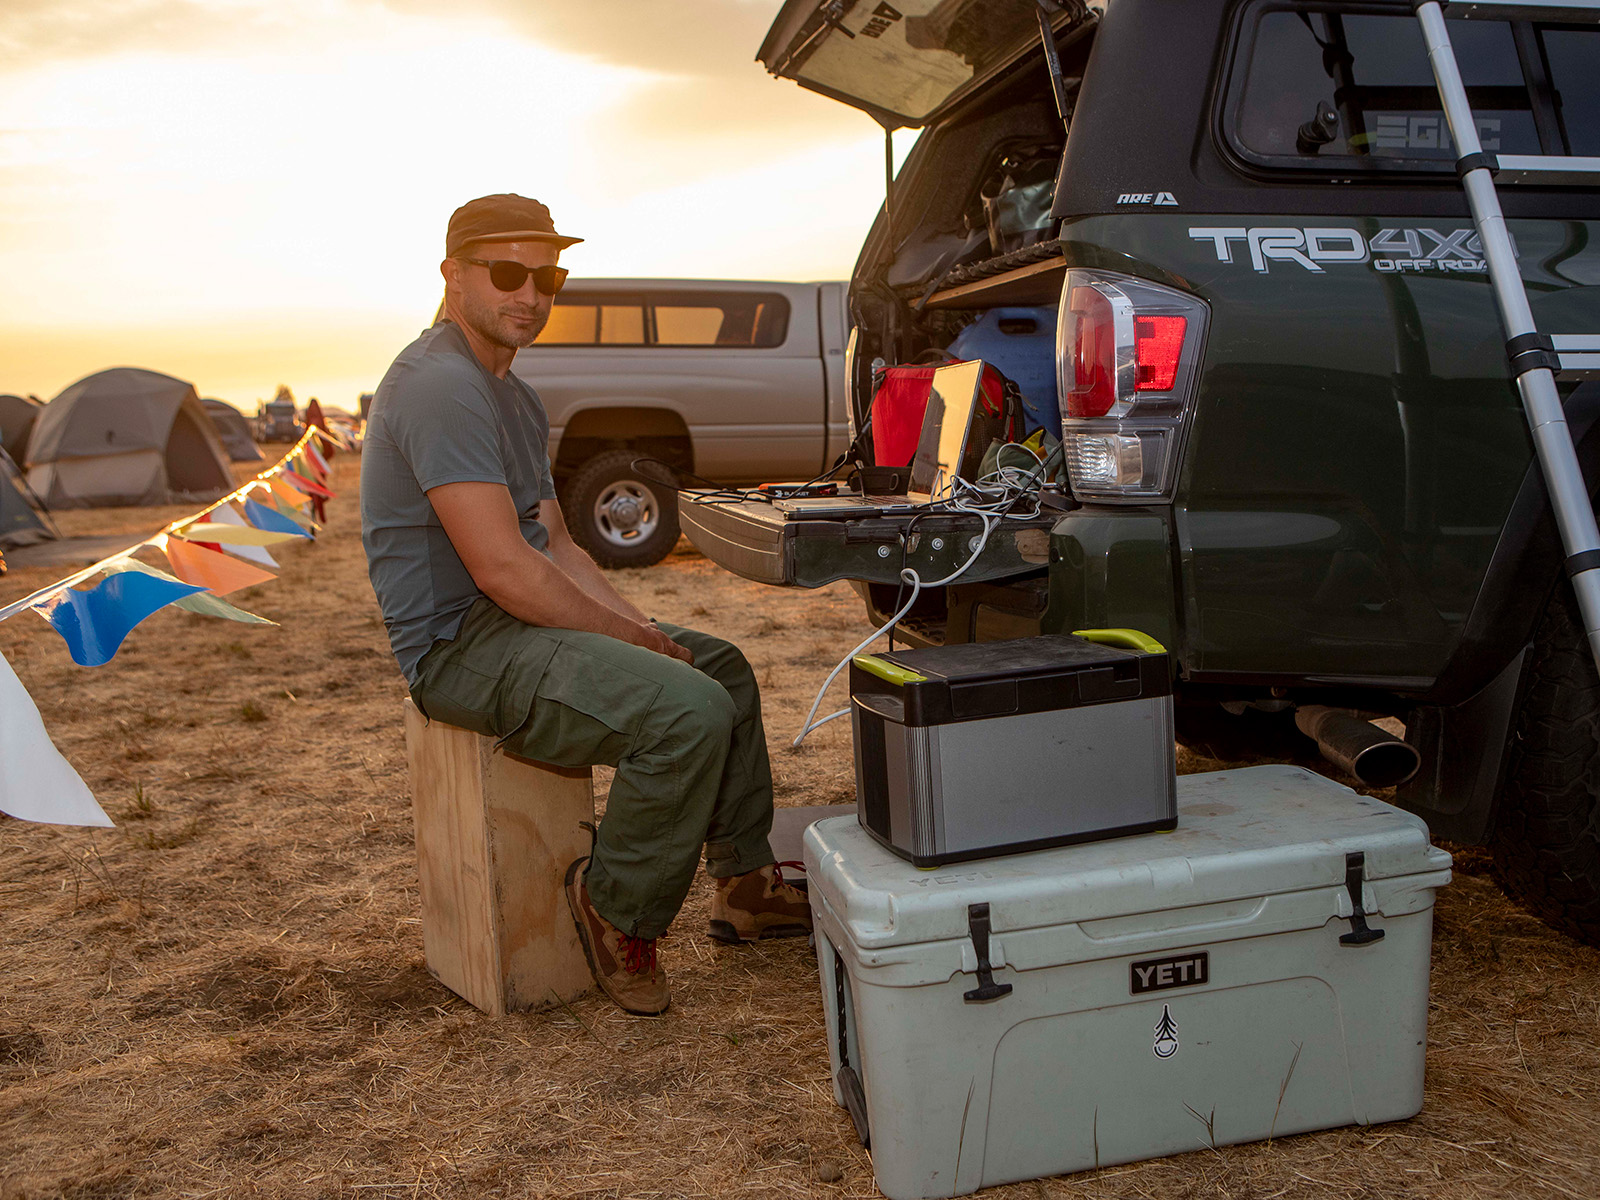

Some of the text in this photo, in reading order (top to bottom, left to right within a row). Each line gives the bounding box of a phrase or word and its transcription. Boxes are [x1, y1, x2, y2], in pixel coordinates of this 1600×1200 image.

[1117, 193, 1153, 204] ARE
[1189, 227, 1370, 273] TRD
[1374, 259, 1435, 273] OFF
[1135, 959, 1202, 988] YETI
